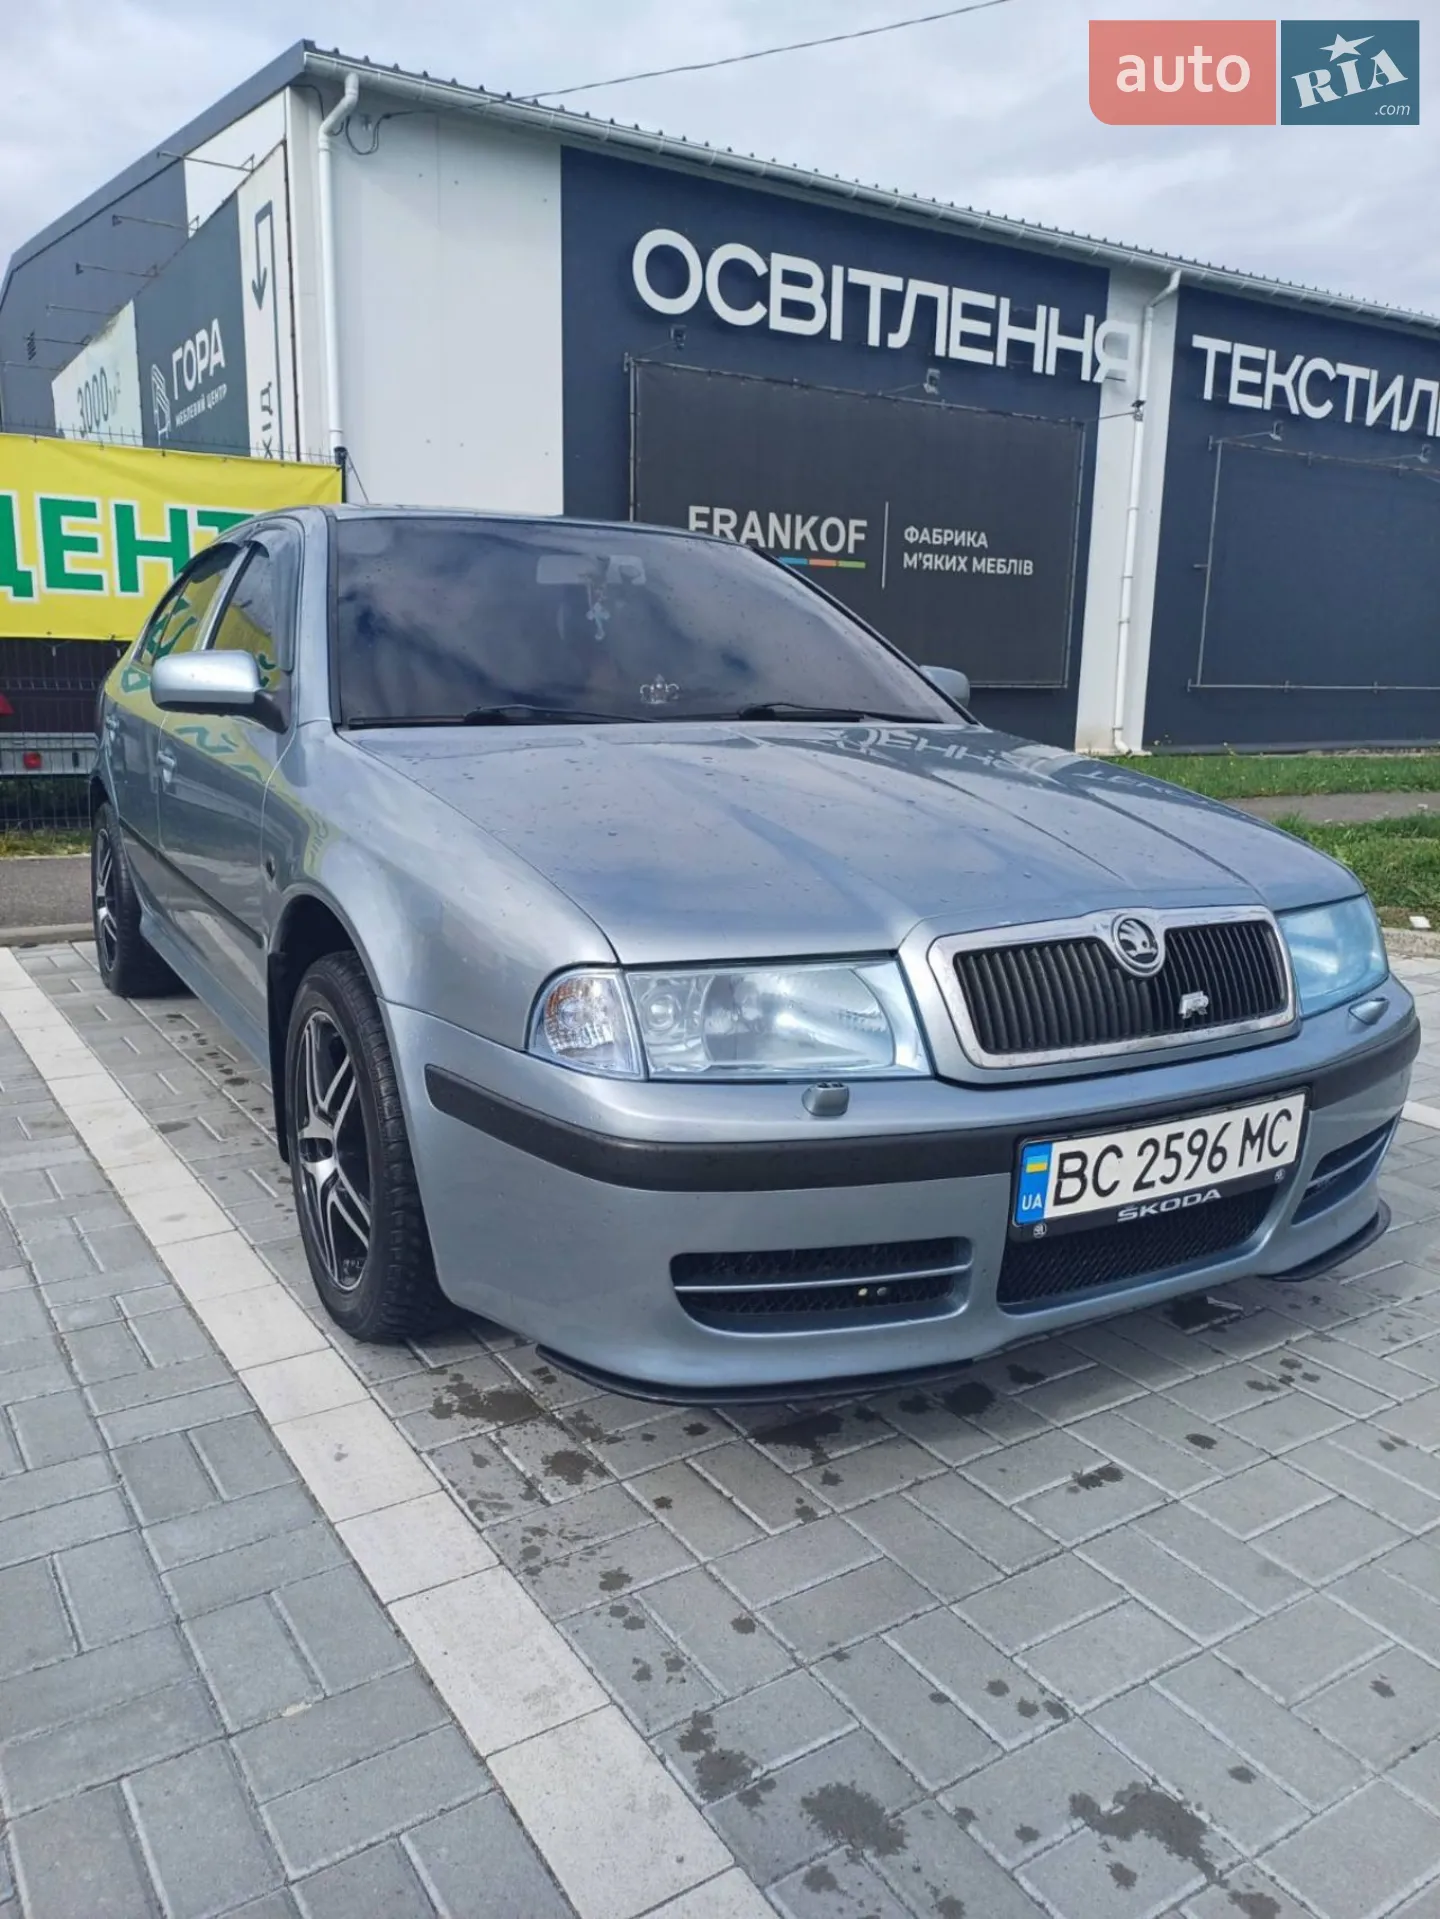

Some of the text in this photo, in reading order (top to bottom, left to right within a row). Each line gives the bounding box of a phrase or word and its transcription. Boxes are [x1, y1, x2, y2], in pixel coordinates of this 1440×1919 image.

[632, 228, 1138, 384] ОСВІТЛЕННЯ
[172, 318, 225, 400] ГОРА
[1192, 334, 1440, 437] ТЕКСТИЛ
[77, 366, 108, 438] 3000
[688, 505, 868, 554] FRANKOF
[903, 525, 988, 549] ФАБРИКА
[903, 552, 1034, 576] М'ЯКИХ МЕБЛІВ
[1053, 1108, 1292, 1206] BC 2596 MC
[1021, 1191, 1043, 1210] UA
